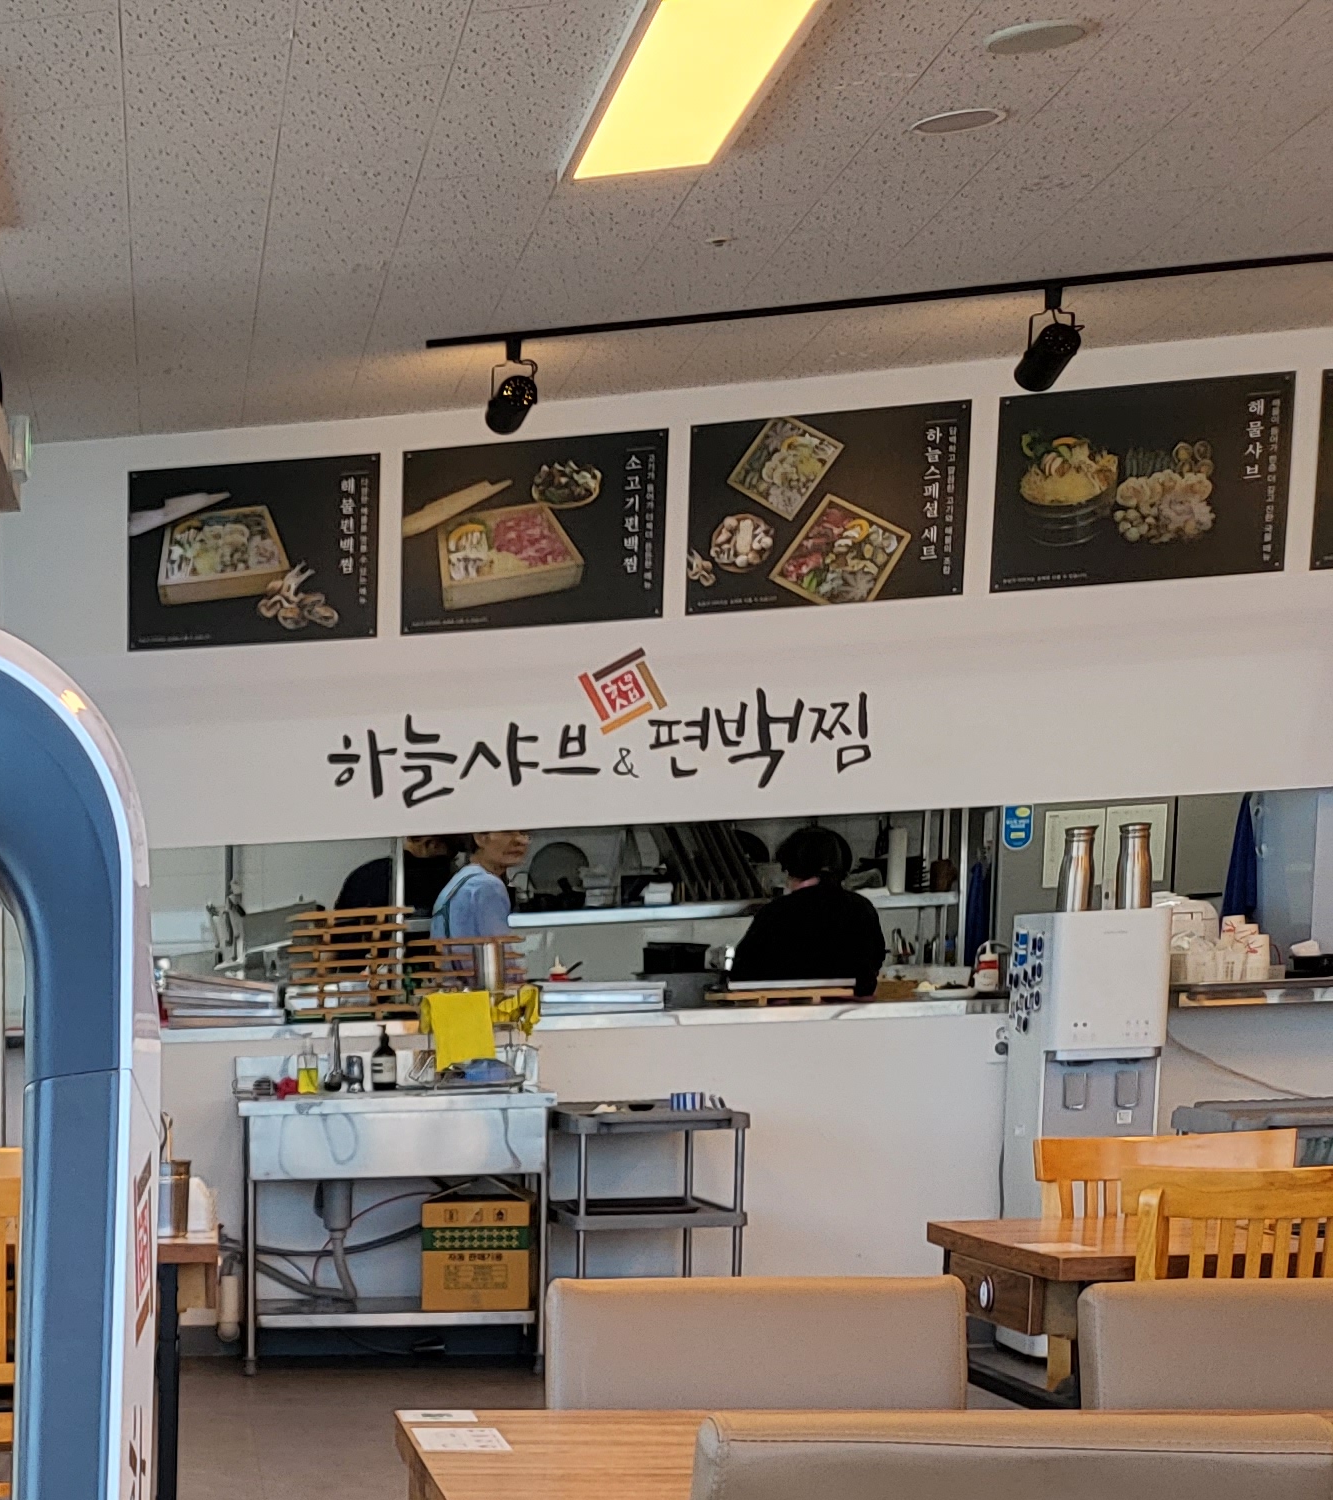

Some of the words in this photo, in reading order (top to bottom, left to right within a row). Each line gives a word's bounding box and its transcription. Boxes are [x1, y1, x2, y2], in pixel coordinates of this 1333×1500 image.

[923, 426, 943, 519] 하늘스페셜
[1243, 398, 1265, 480] 해물샤브
[339, 476, 357, 574] 해물편백찜
[623, 454, 643, 573] 소고기편백찜
[920, 525, 938, 561] 세트
[327, 713, 601, 809] 하늘샤브
[612, 748, 640, 779] &
[648, 687, 872, 790] 편백찜
